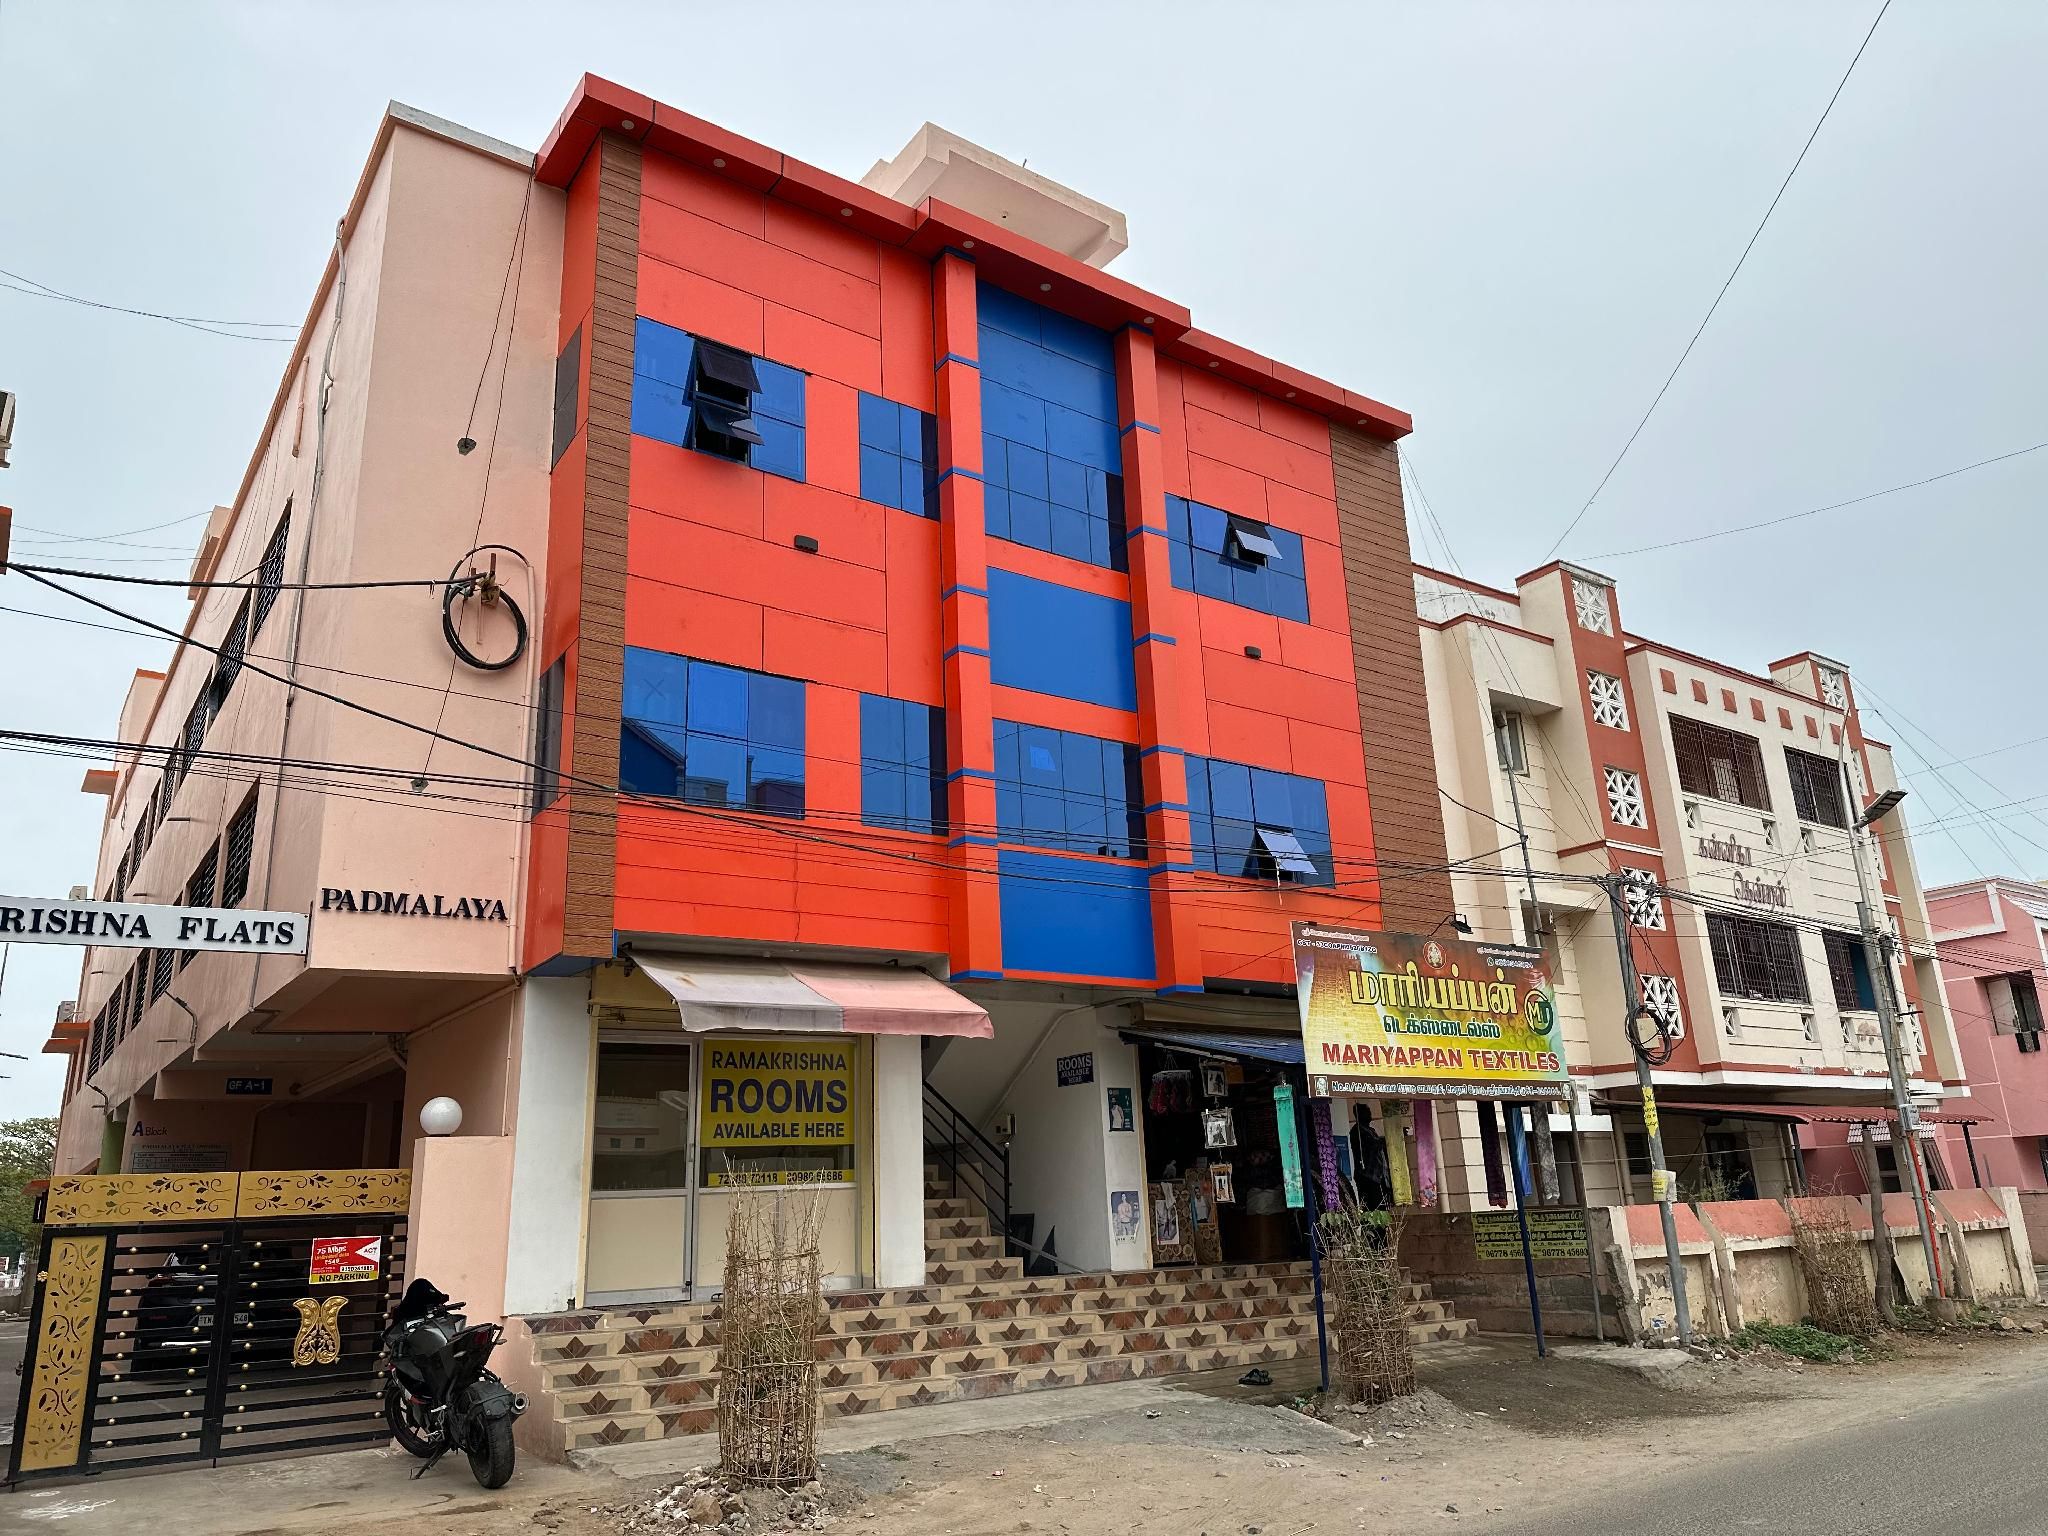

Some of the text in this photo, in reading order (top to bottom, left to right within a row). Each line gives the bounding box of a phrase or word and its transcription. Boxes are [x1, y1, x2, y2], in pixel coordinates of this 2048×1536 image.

[321, 887, 508, 920] PADMALAYA
[0, 907, 294, 944] RISHNA FLATS
[1348, 960, 1518, 1014] மாரியப்பன்
[1383, 1013, 1501, 1038] டெக்ஸ்டைல்ஸ்
[711, 1050, 847, 1070] RAMAKRISHNA
[1058, 1055, 1092, 1072] ROOMS
[1322, 1042, 1560, 1072] MARIYAPPAN TEXTILES
[1061, 1068, 1089, 1078] AVAILABLE
[1068, 1076, 1082, 1084] HERE
[228, 1080, 265, 1091] GF A-1
[710, 1078, 847, 1113] ROOMS
[132, 1121, 168, 1136] A Block
[713, 1123, 845, 1138] AVAILABLE HERE
[327, 1246, 347, 1254] Mbps
